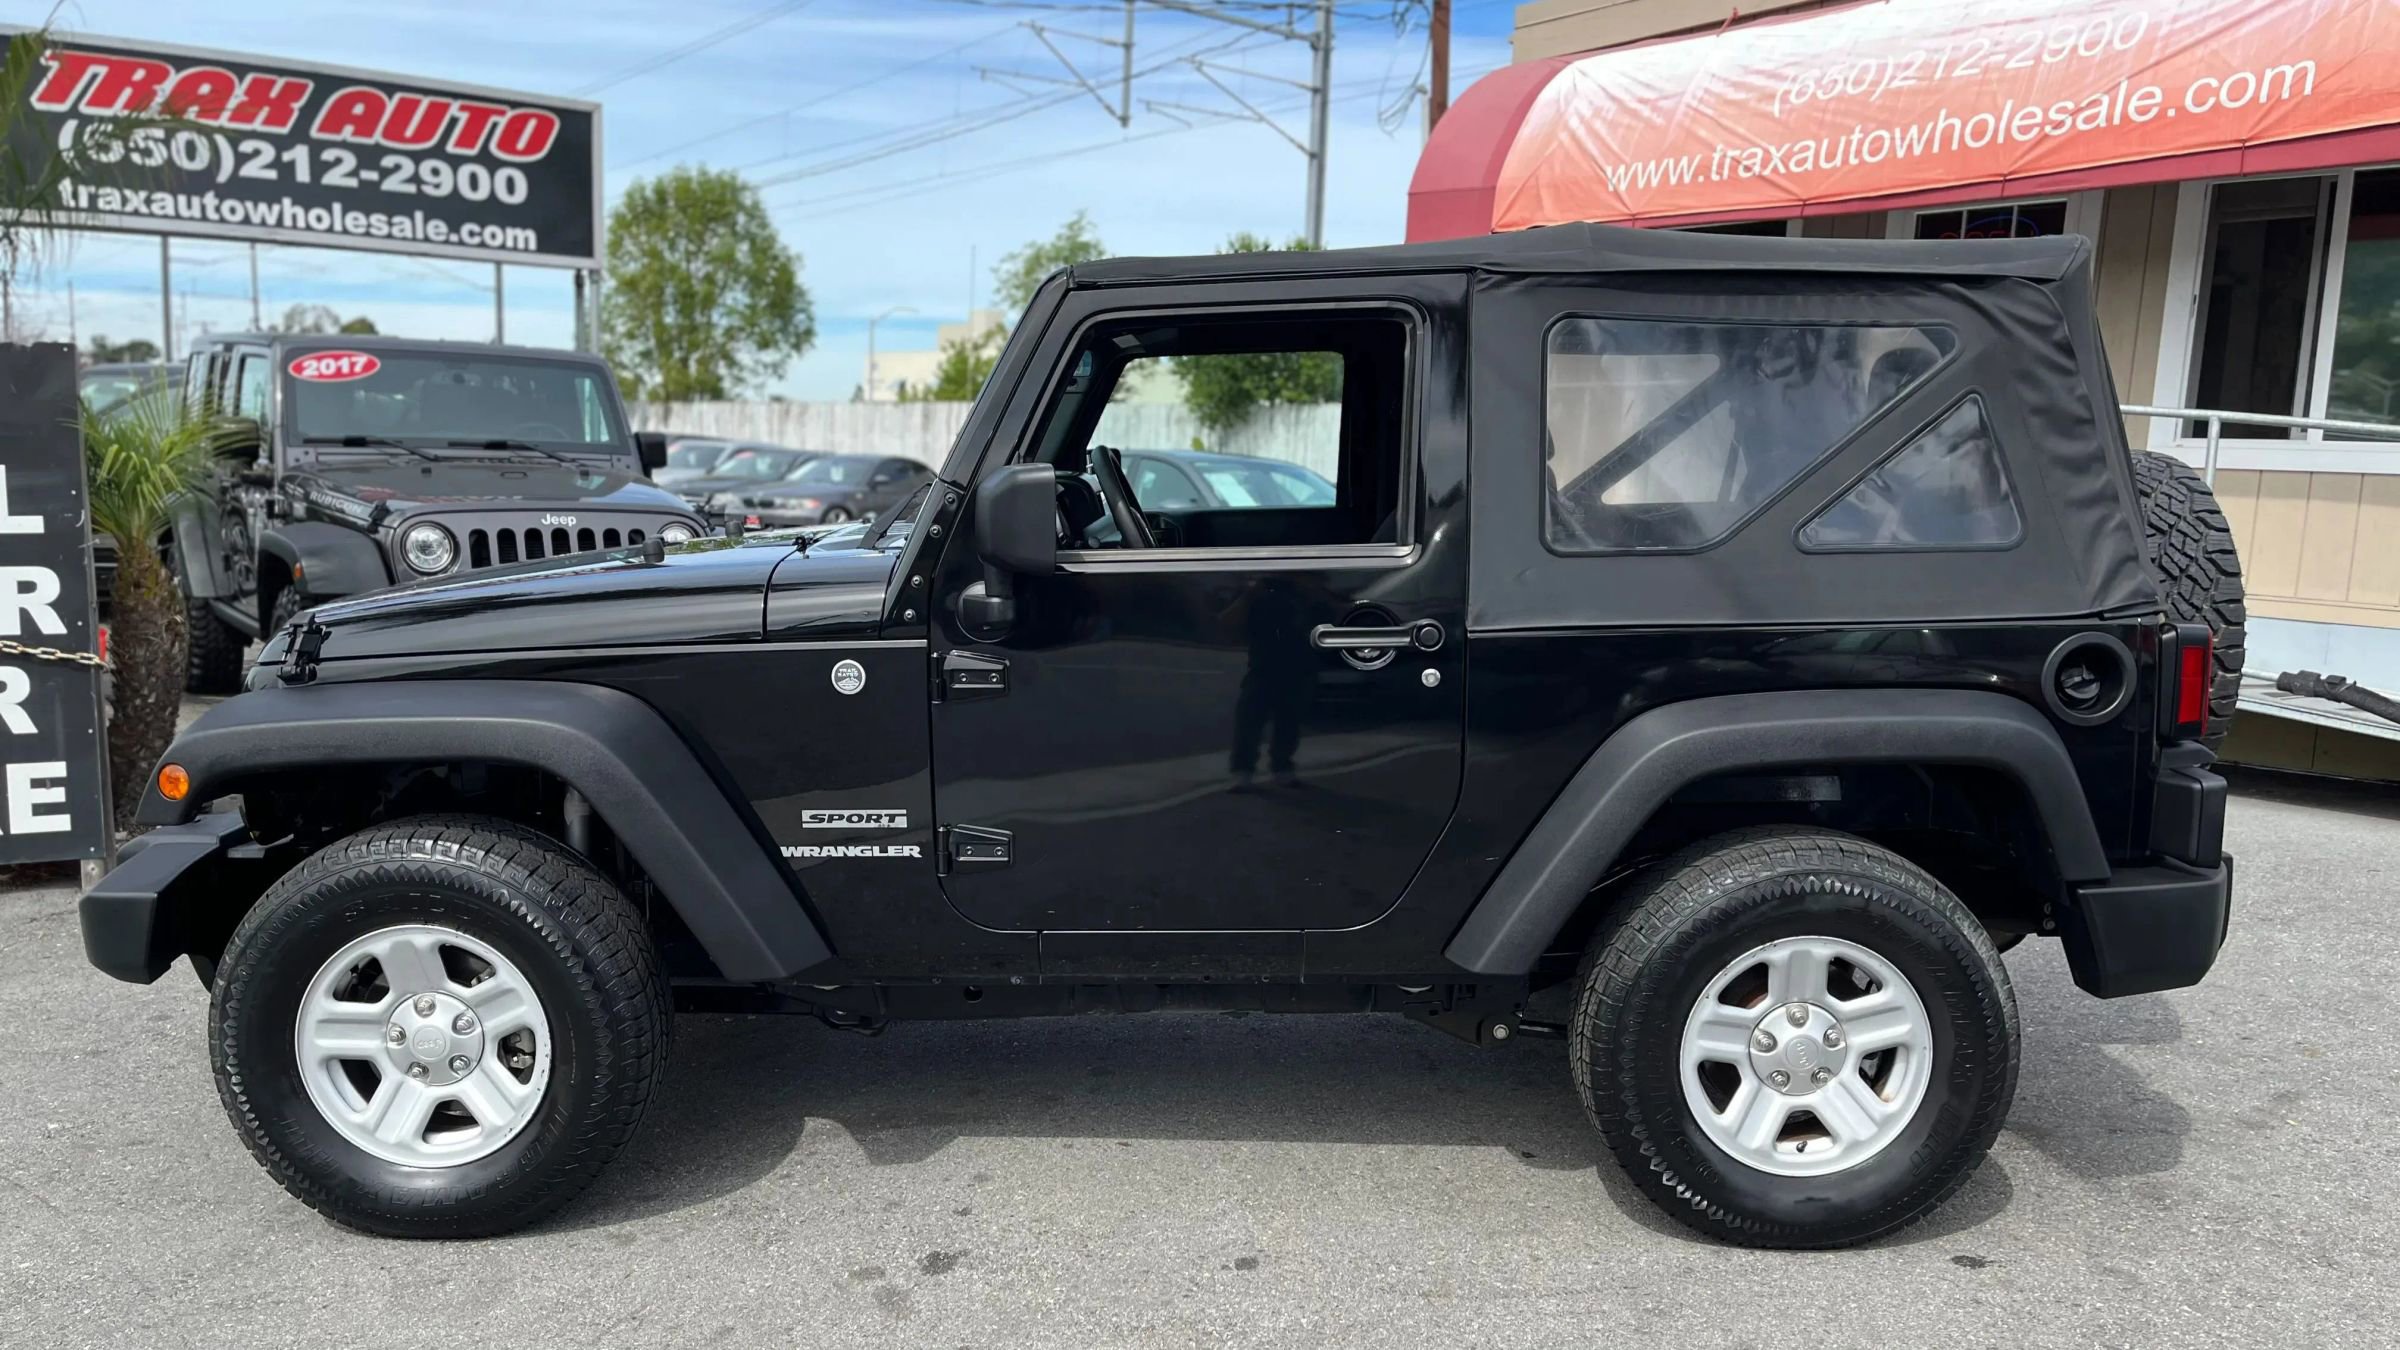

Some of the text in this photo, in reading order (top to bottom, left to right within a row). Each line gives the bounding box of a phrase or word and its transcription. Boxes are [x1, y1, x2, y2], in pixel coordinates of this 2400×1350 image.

[1773, 11, 2150, 118] (650)212-2900
[30, 49, 560, 162] TRAX AUTO
[1605, 60, 2316, 192] www.traxautowholesale.com
[57, 119, 529, 205] (650)212-2900
[57, 176, 538, 251] traxautowholesale.com
[301, 356, 368, 377] 2017
[309, 490, 364, 515] RUBICON
[541, 513, 577, 527] Jeep
[0, 761, 72, 835] E
[809, 813, 906, 824] SPORT
[780, 845, 922, 857] WRANGLER
